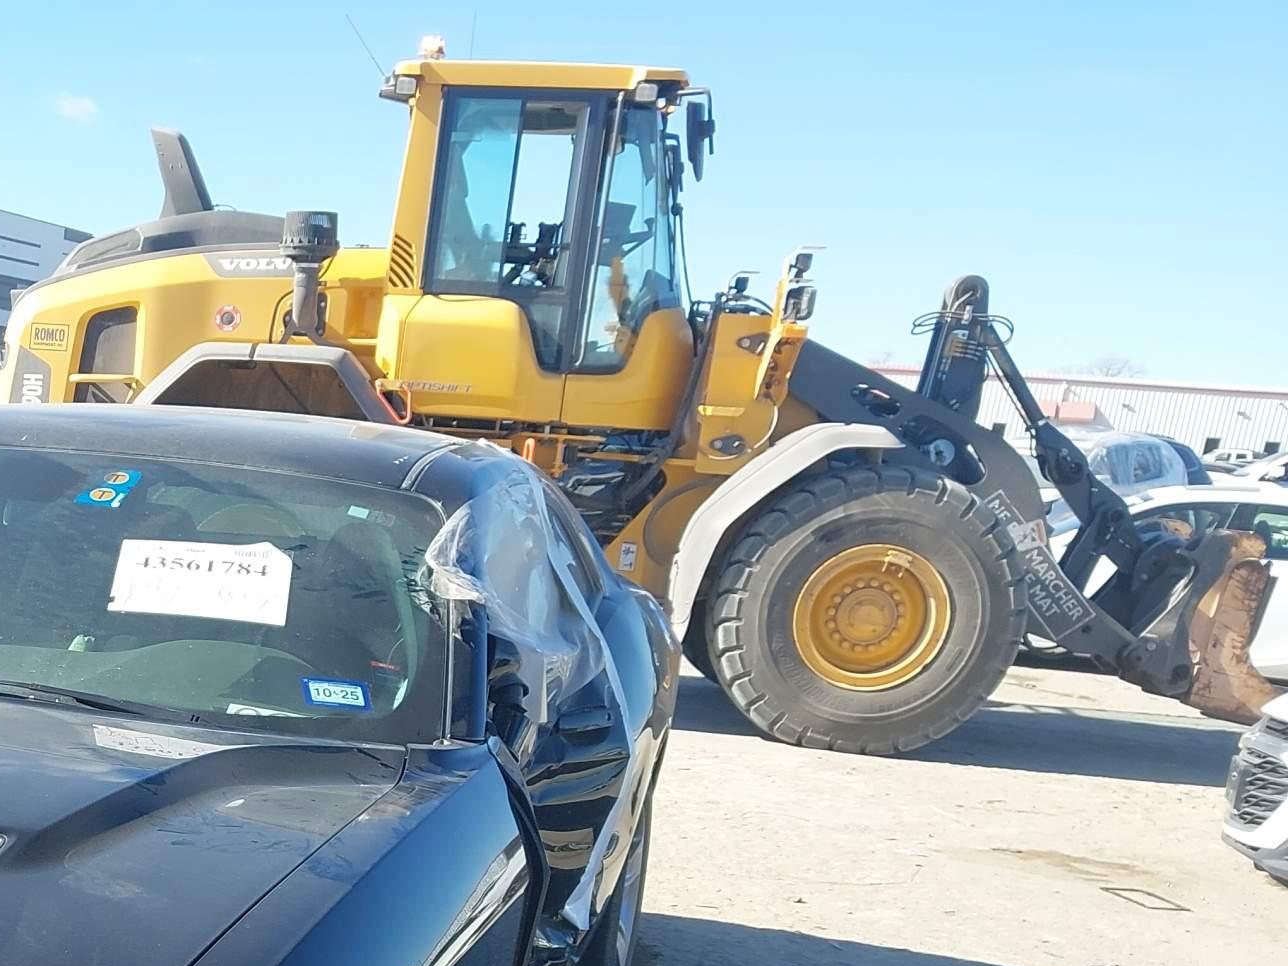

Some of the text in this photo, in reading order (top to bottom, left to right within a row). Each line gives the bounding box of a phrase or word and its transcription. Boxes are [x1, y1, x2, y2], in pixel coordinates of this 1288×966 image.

[218, 257, 293, 270] VOLV
[34, 327, 66, 342] ROMCO
[135, 556, 269, 577] 43561784
[1025, 549, 1084, 622] MARCHER
[1029, 584, 1061, 618] MAT
[313, 687, 360, 701] 10 25
